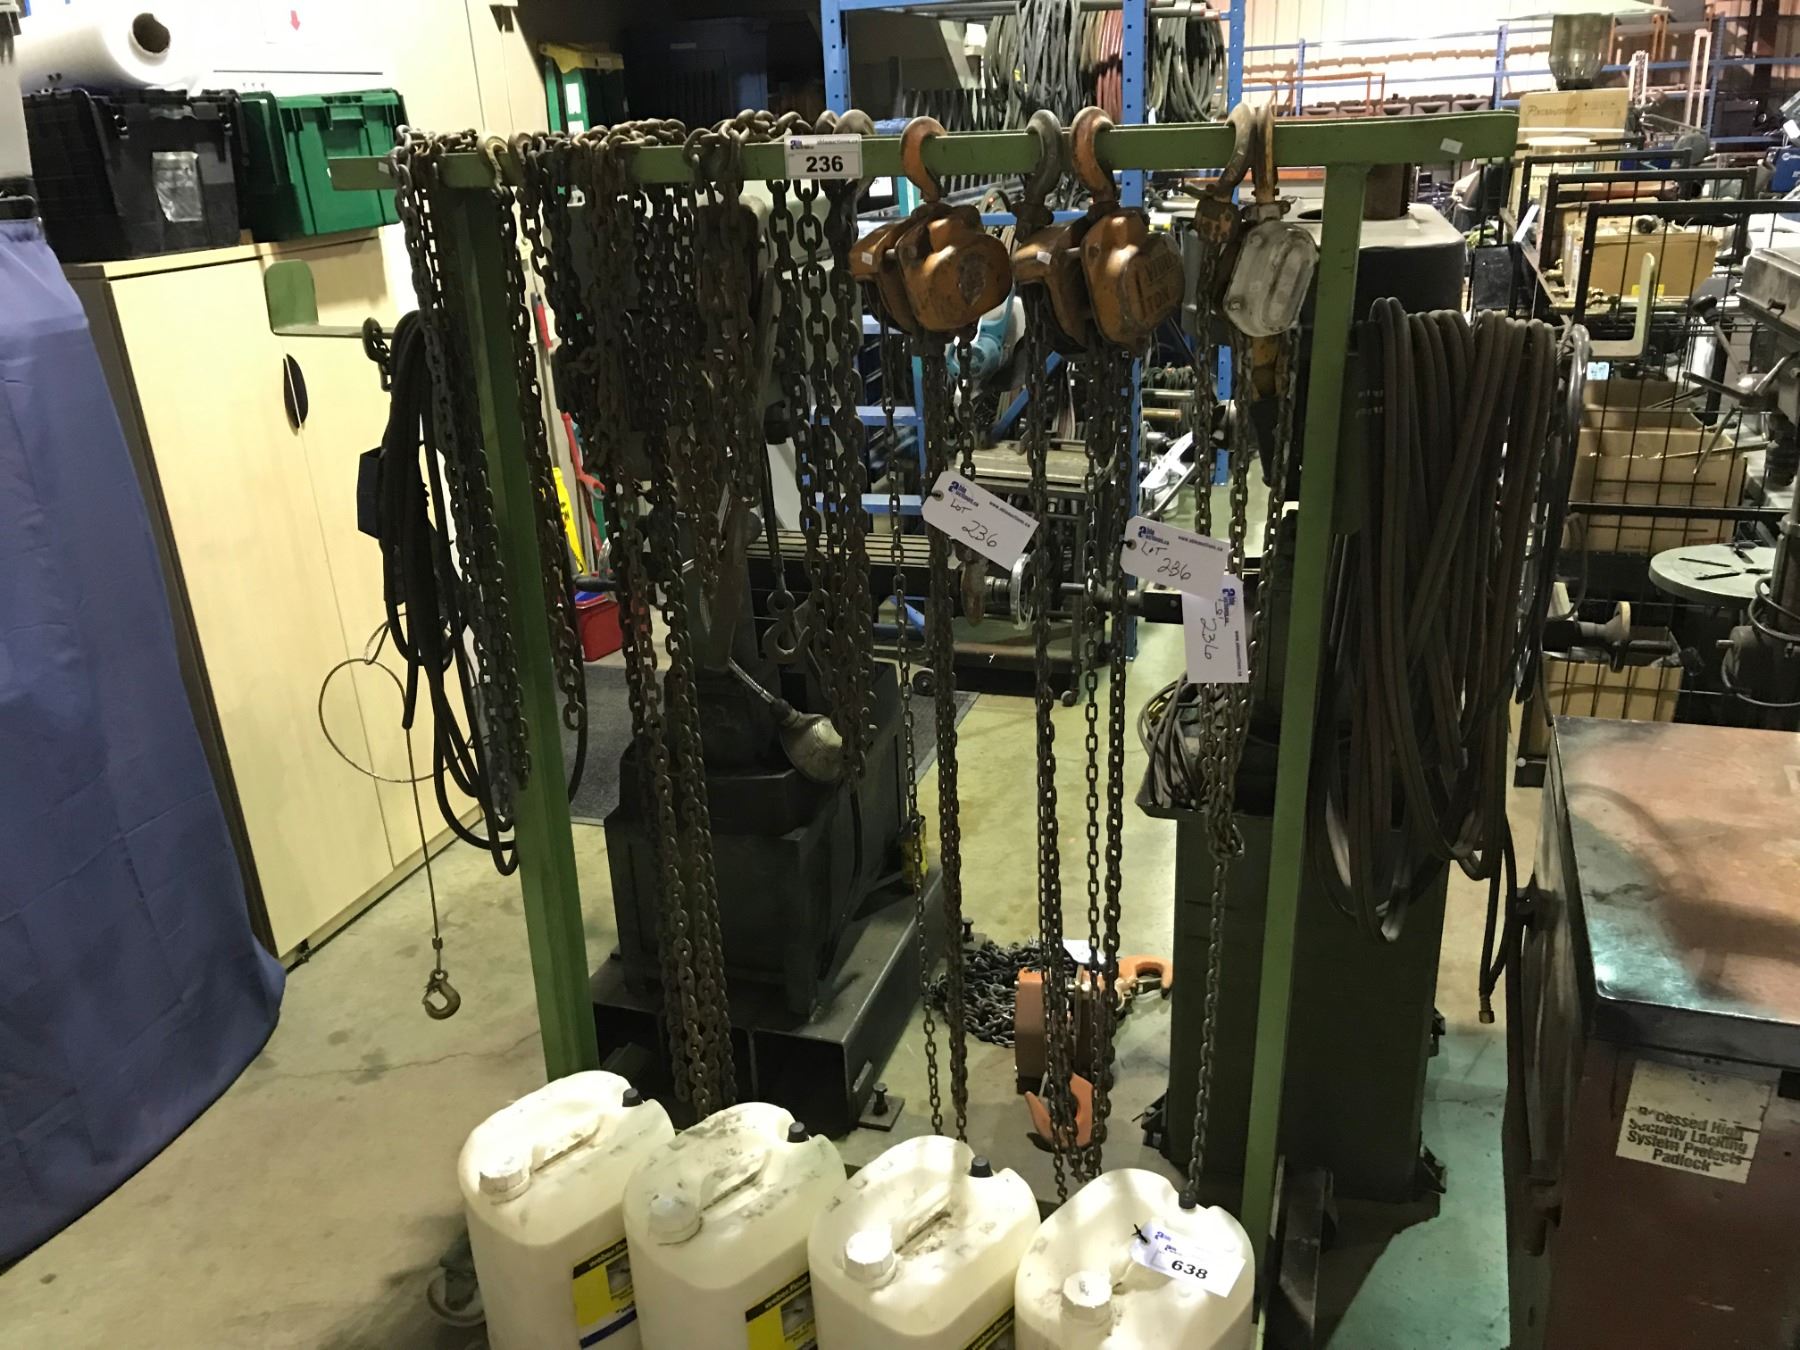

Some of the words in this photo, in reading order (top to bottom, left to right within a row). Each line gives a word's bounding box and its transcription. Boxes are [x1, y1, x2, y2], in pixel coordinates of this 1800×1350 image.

[806, 155, 844, 173] 236
[961, 520, 999, 547] 236
[1157, 557, 1192, 580] 236
[1627, 1130, 1680, 1152] System
[1683, 1142, 1743, 1165] Protects
[1628, 1118, 1687, 1142] Security
[1690, 1130, 1748, 1154] Locking
[1652, 1148, 1711, 1172] Padlock
[1171, 1260, 1208, 1279] 638
